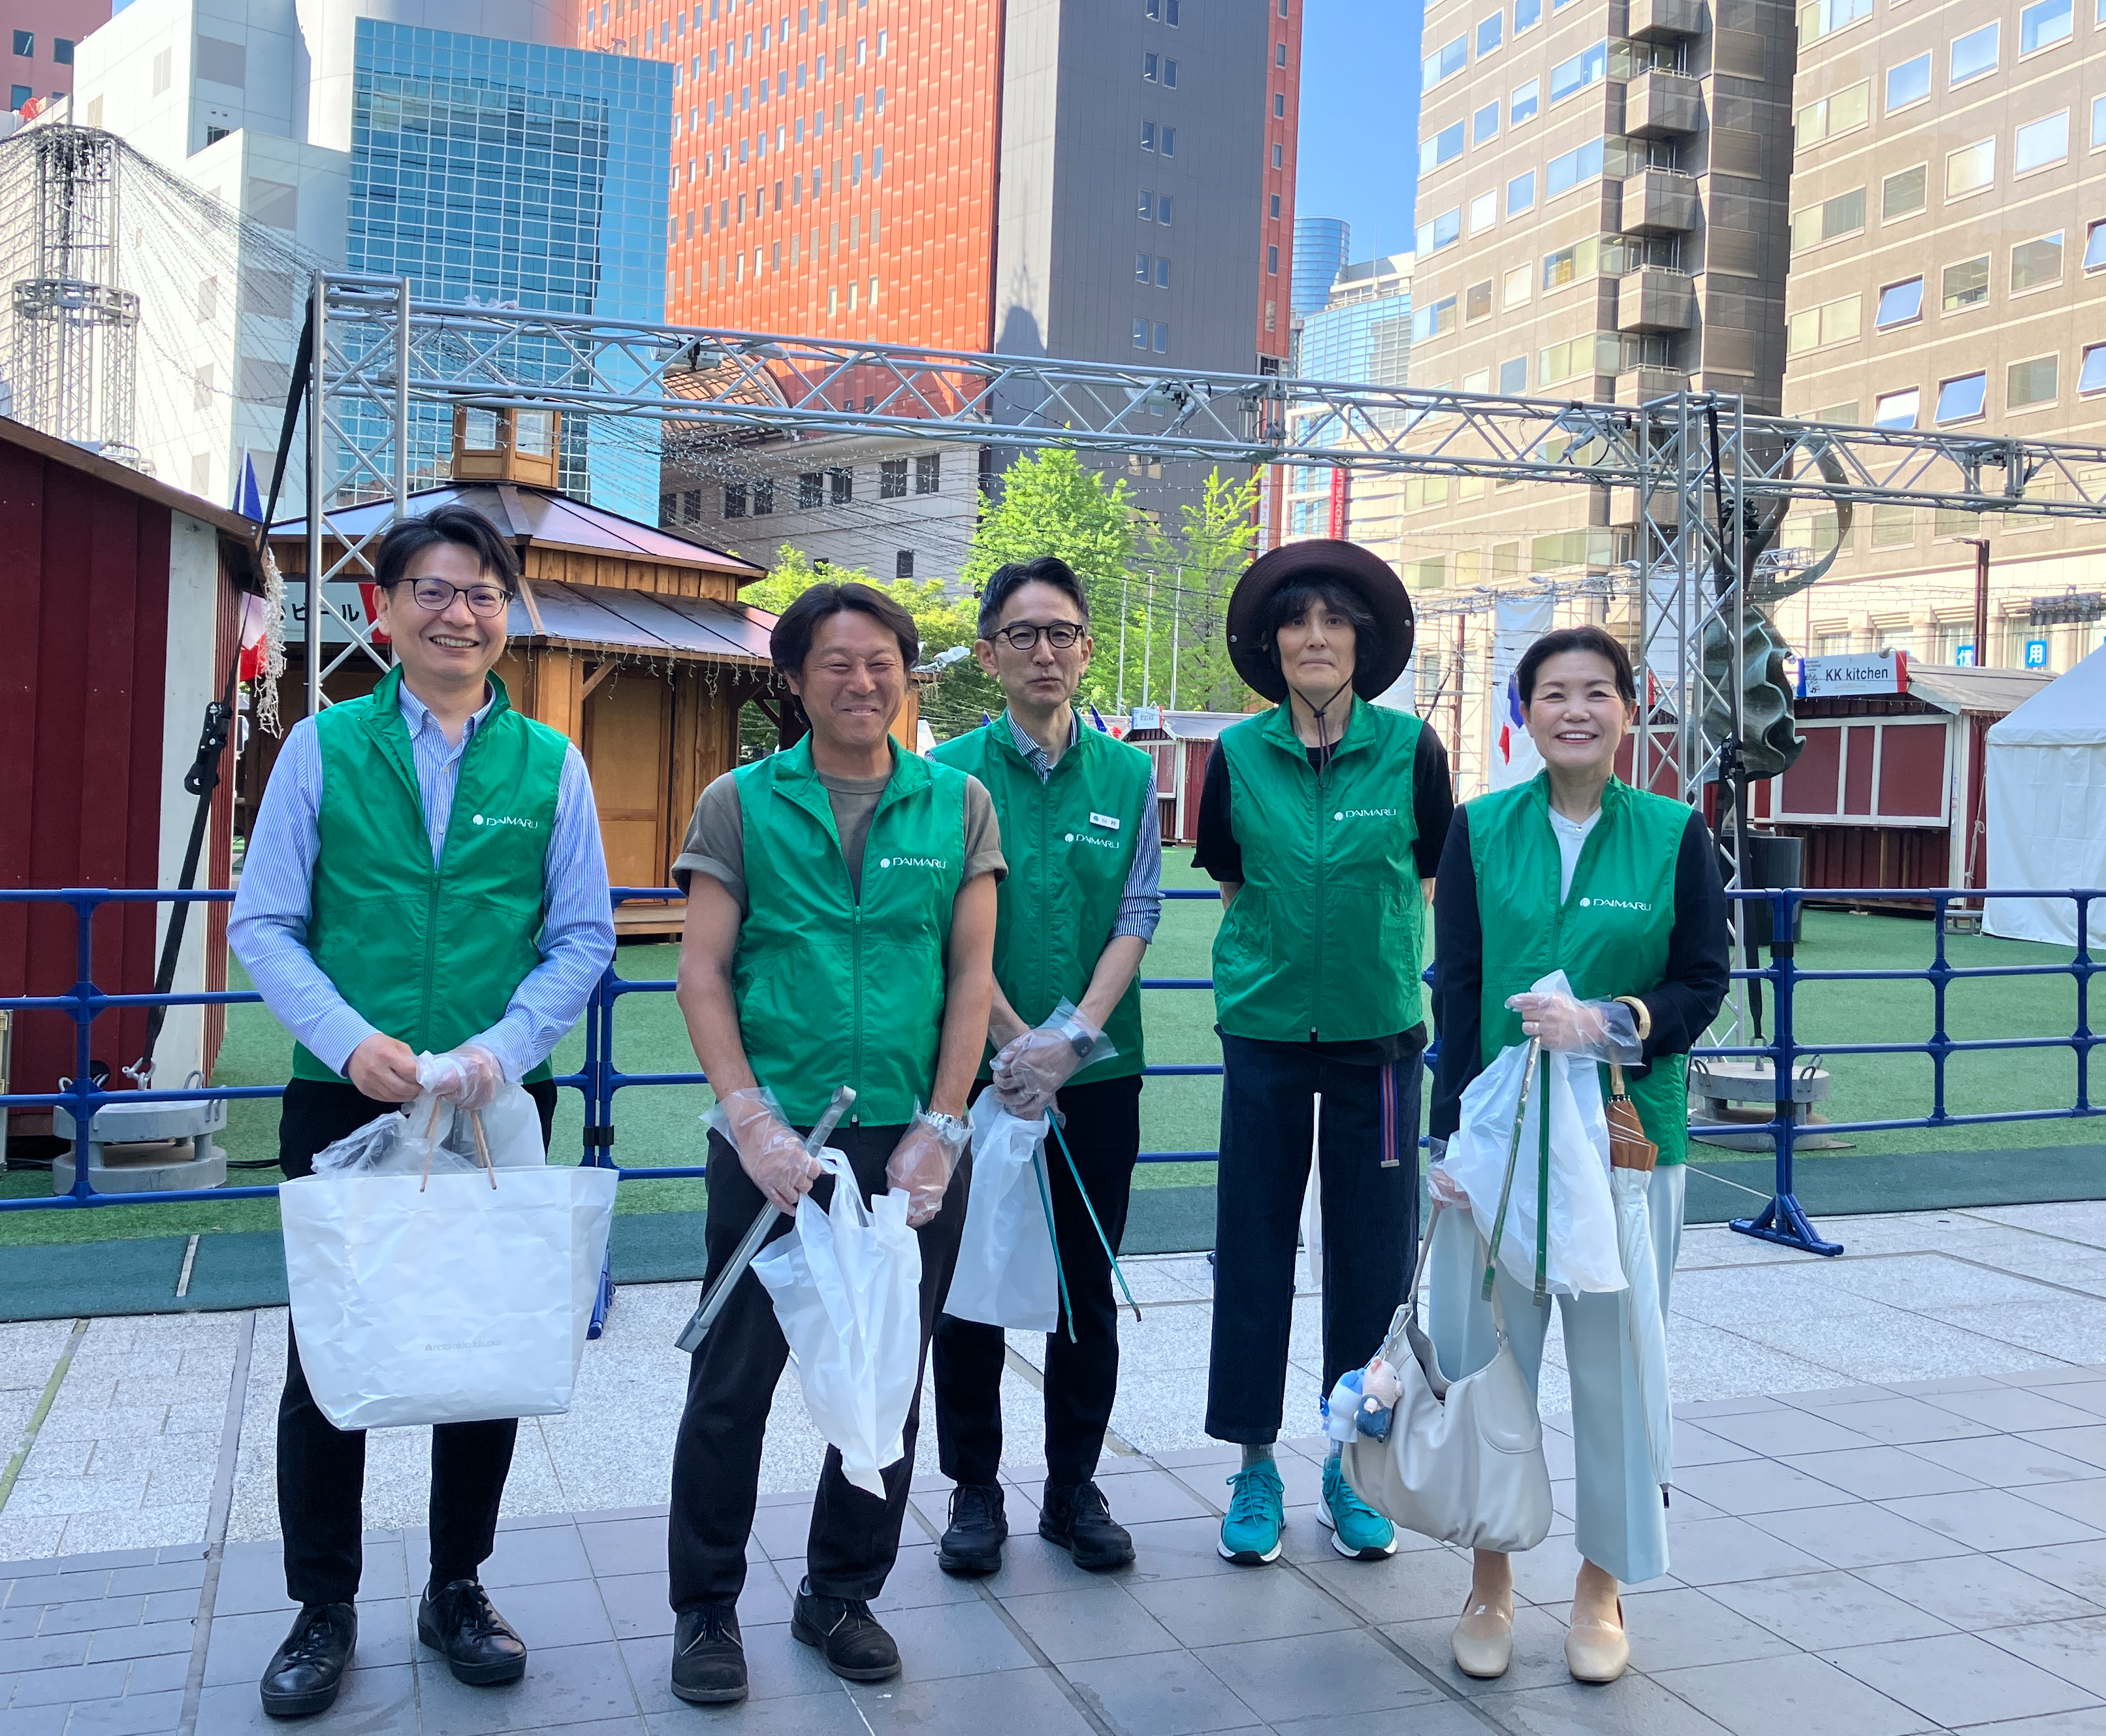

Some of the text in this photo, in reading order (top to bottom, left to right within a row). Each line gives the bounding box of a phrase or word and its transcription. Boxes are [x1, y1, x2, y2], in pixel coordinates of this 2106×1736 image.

[2028, 645, 2043, 664] 用
[1826, 667, 1888, 681] KK kitchen
[1346, 809, 1396, 818] DAIMARU
[486, 816, 537, 828] DAIMARU
[1076, 834, 1119, 848] DAIMARU
[893, 858, 946, 869] DAIMARU
[1593, 899, 1651, 910] DAIMARU
